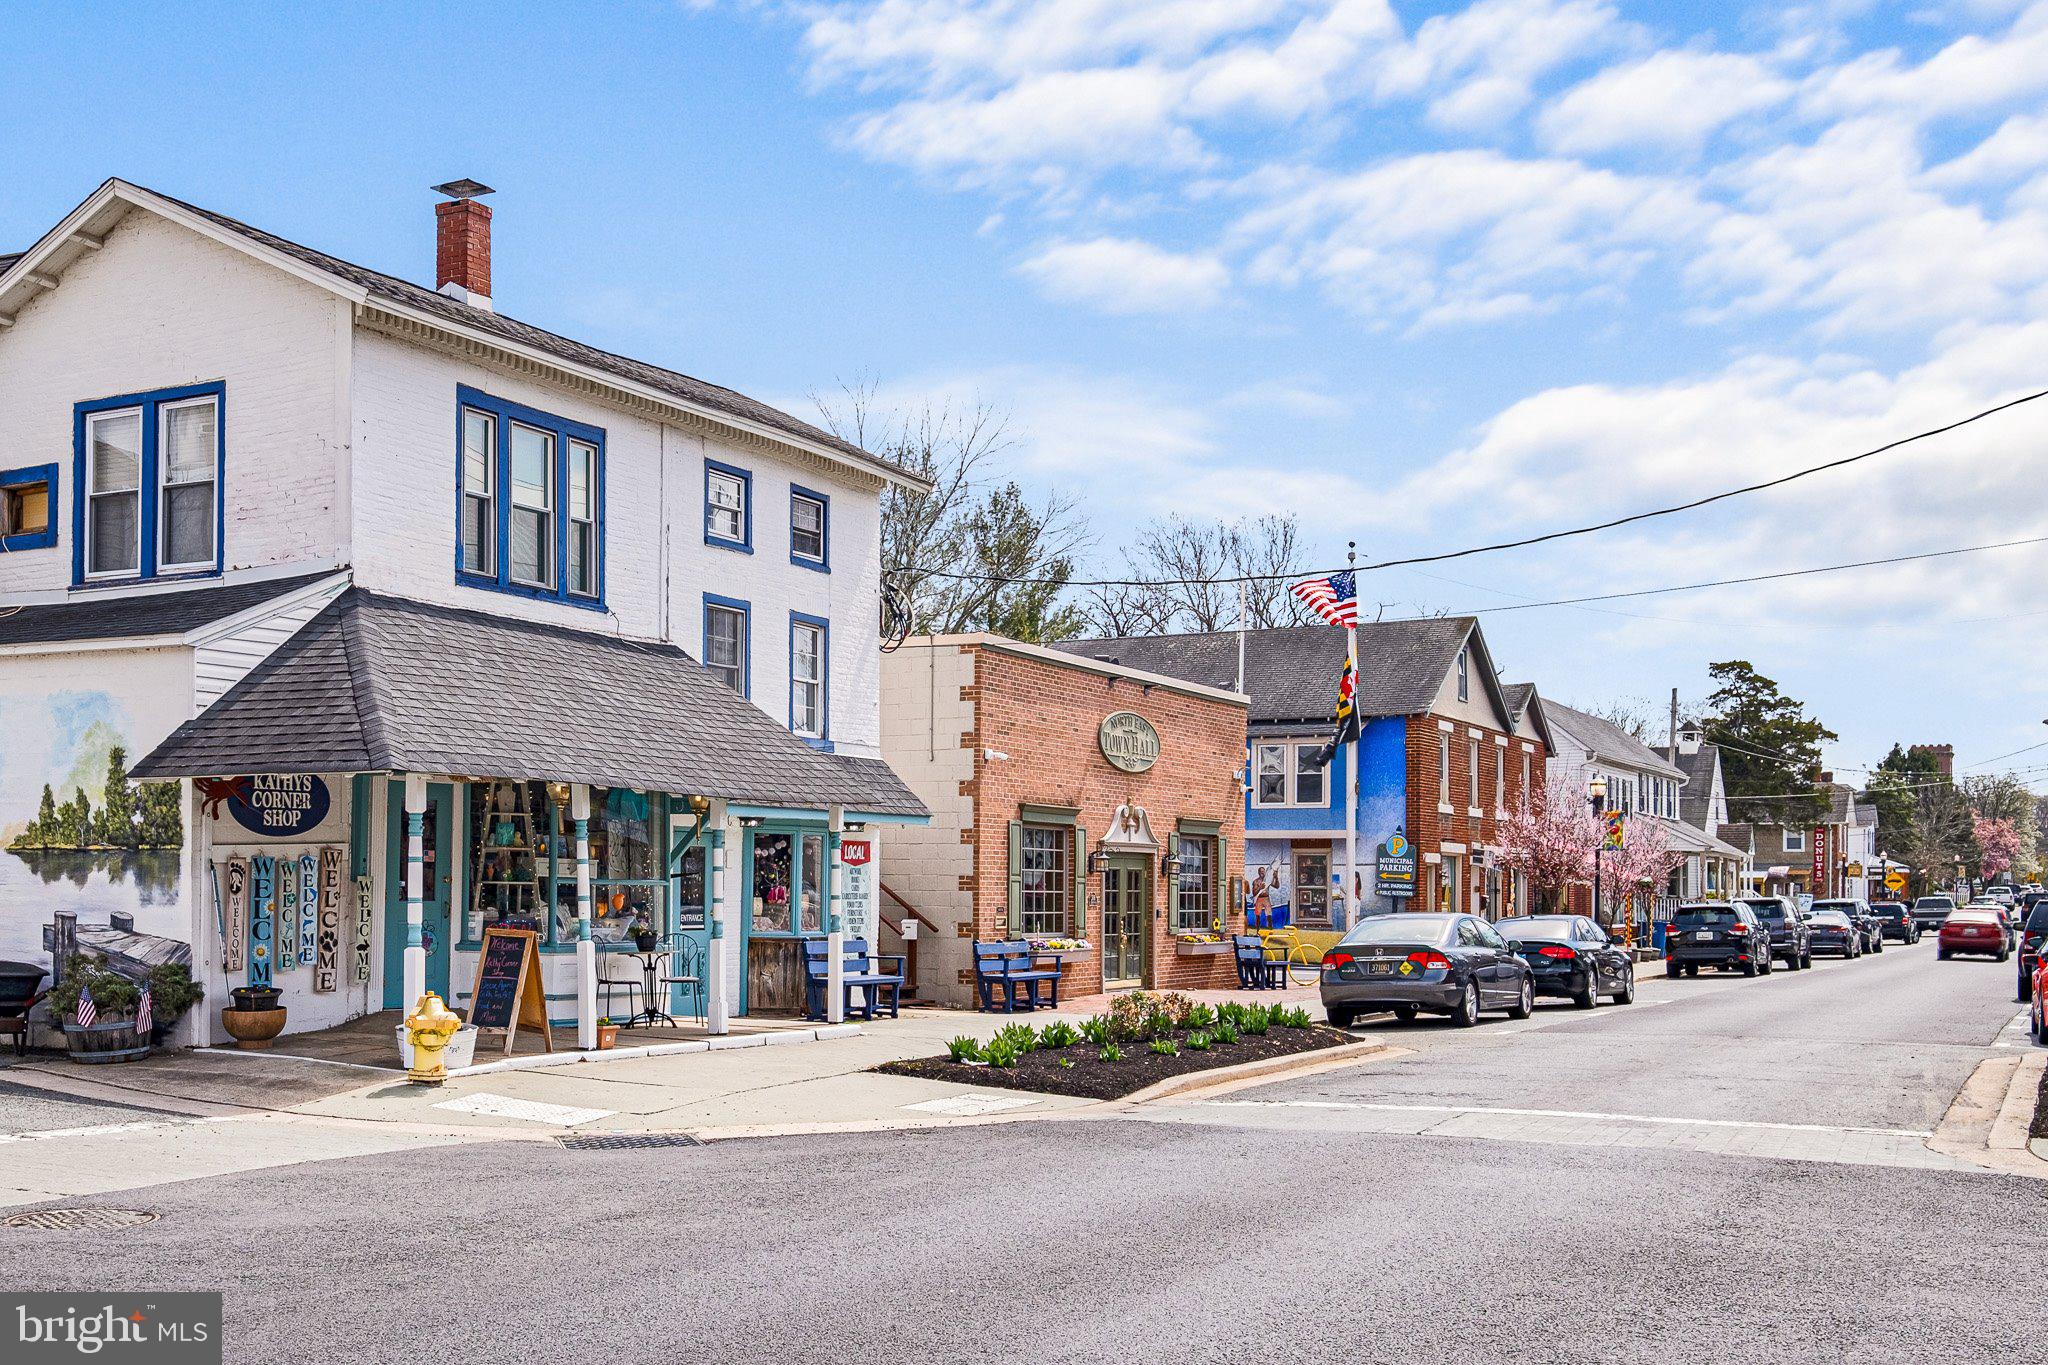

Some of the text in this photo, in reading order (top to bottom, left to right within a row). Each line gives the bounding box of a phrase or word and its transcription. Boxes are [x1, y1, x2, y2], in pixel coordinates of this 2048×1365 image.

[1110, 715, 1133, 730] NORTH
[1103, 731, 1157, 757] TOWN HALL
[253, 774, 312, 791] KATHYS
[252, 791, 312, 809] CORNER
[263, 809, 301, 827] SHOP
[844, 845, 865, 860] LOCAL
[1391, 837, 1404, 855] P
[1379, 857, 1413, 865] MUNICIPAL
[1815, 833, 1824, 878] DONUTS
[1379, 864, 1413, 872] PARKING
[681, 913, 704, 922] ENTRANCE
[232, 897, 241, 969] WELCOME
